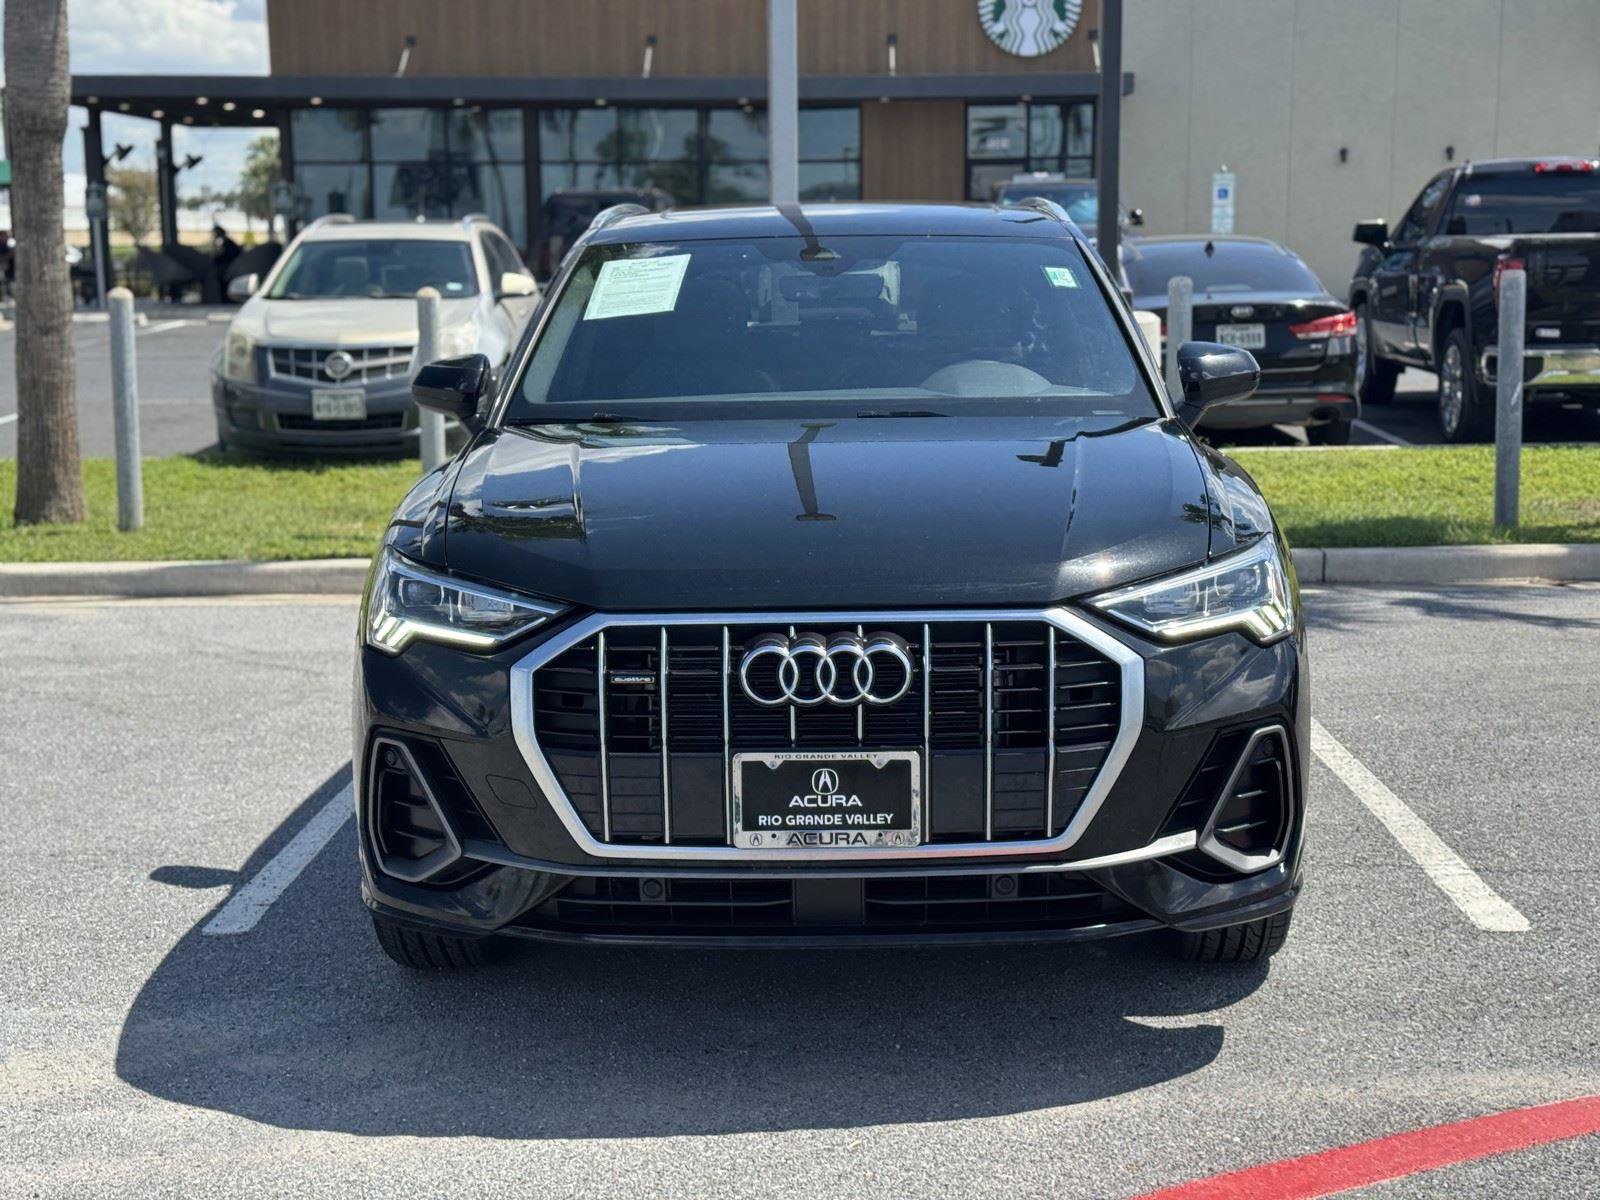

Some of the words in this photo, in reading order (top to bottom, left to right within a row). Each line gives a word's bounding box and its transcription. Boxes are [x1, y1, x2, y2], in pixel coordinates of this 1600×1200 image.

[789, 794, 863, 808] ACURA
[758, 814, 782, 826] RIO
[785, 814, 842, 826] GRANDE
[845, 813, 894, 825] VALLEY
[786, 832, 868, 846] ACURA
